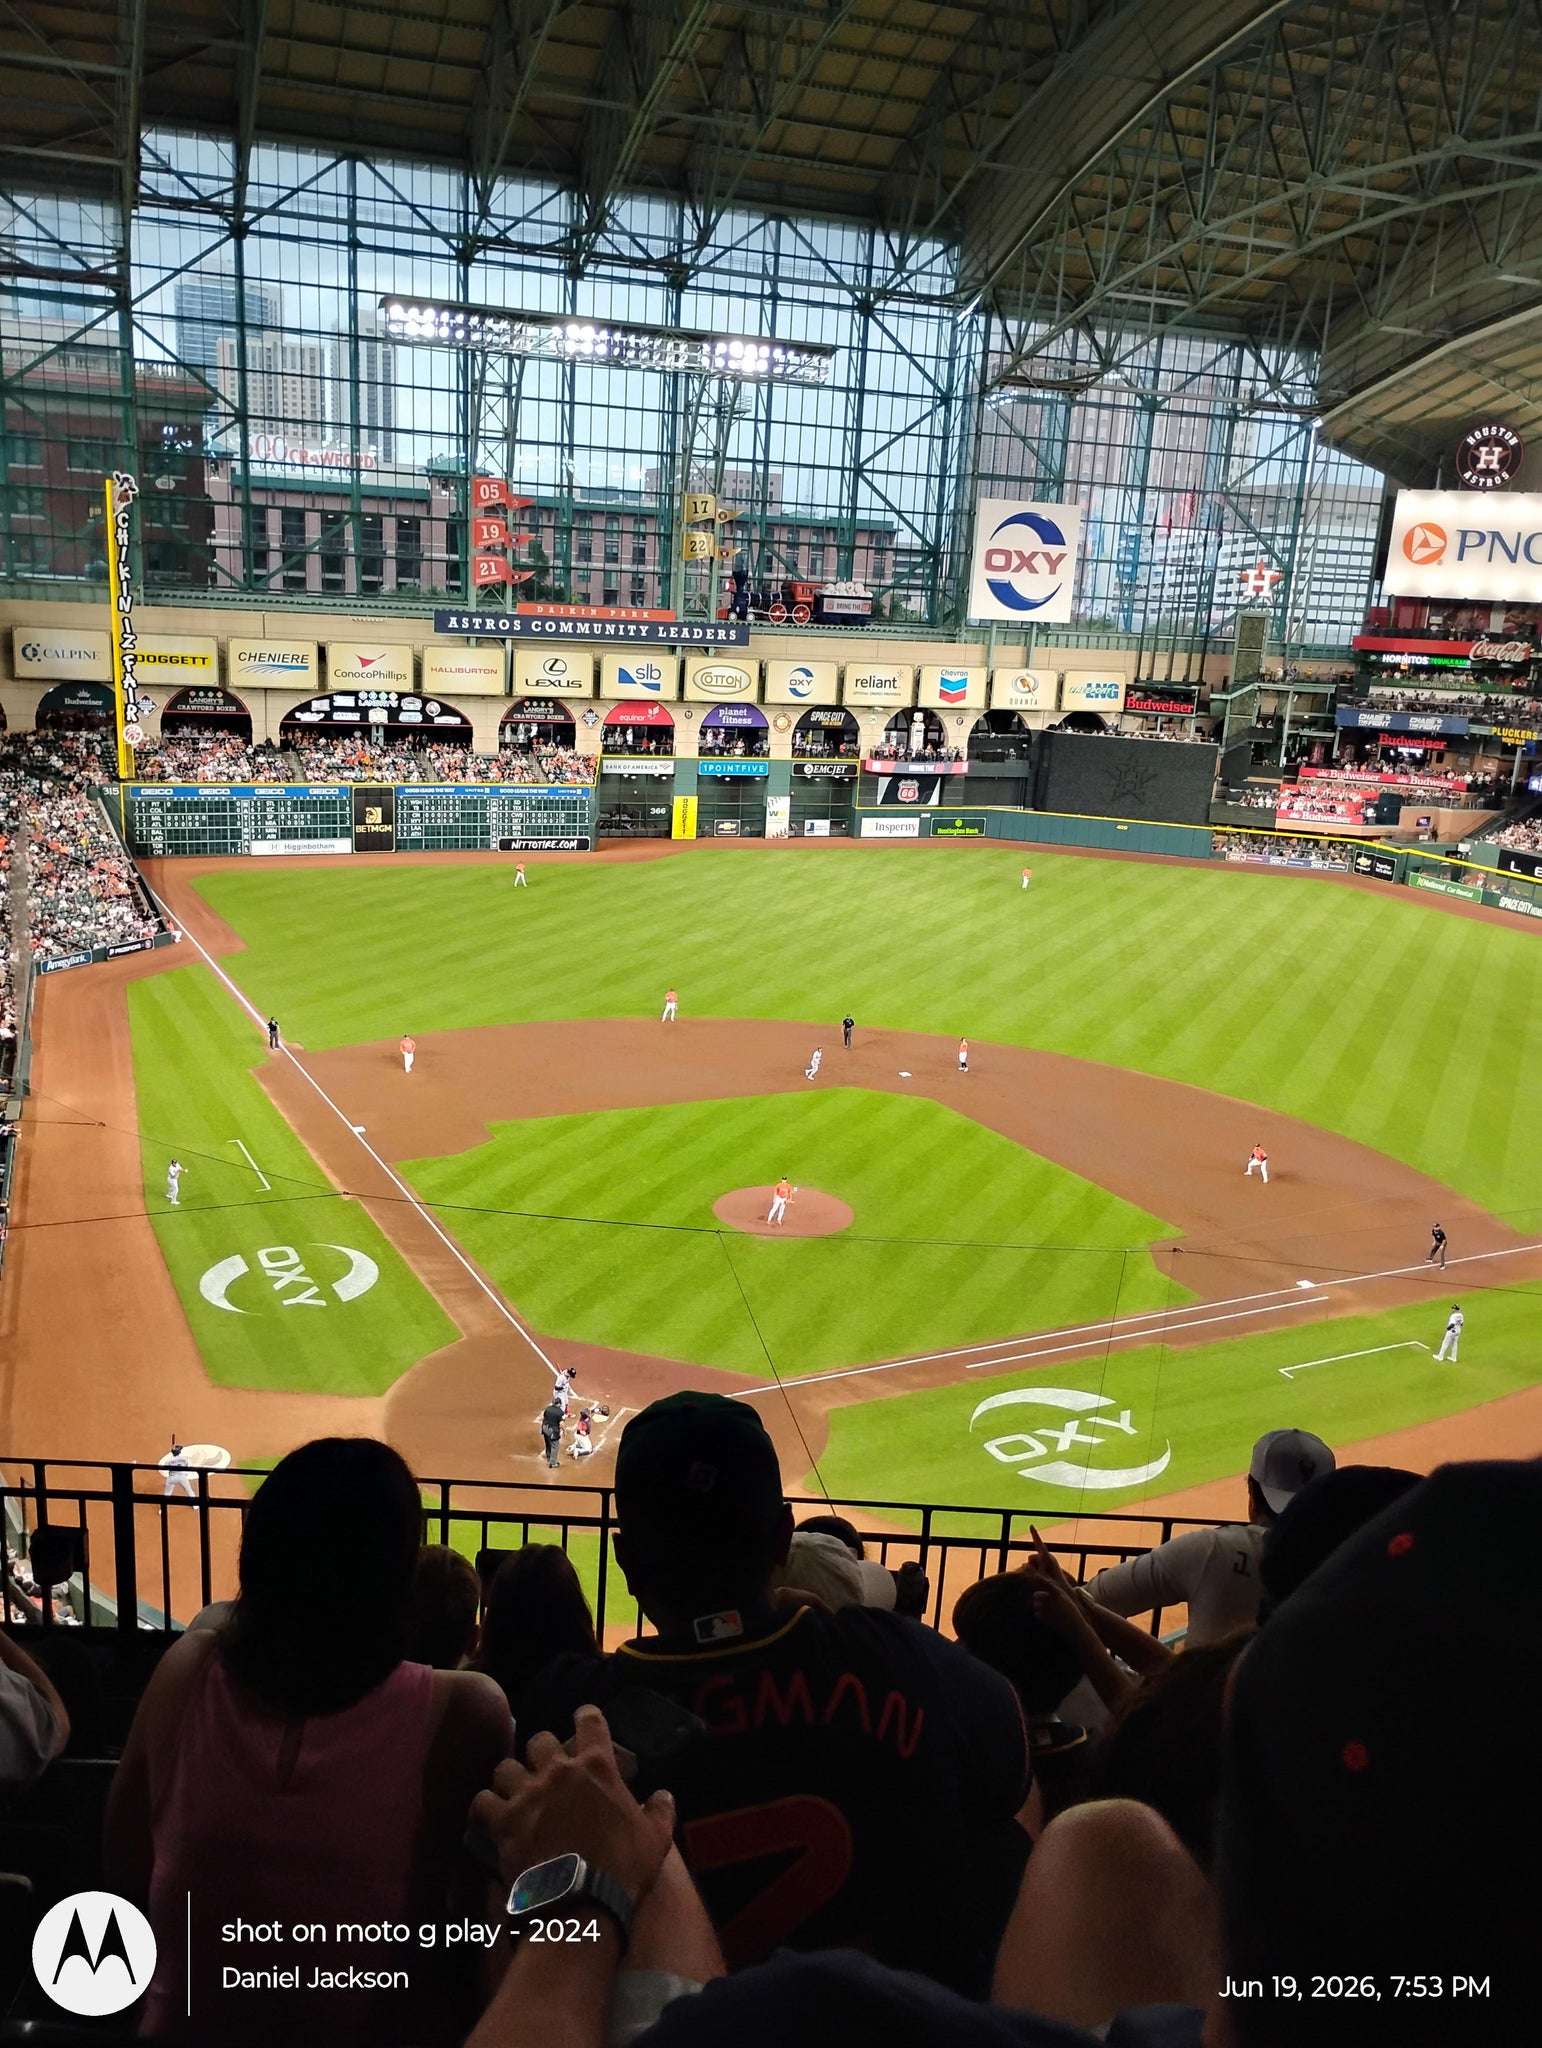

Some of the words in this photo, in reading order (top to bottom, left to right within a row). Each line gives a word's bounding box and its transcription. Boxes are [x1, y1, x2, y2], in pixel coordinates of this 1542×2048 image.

[1467, 426, 1518, 446] HOUSTON
[248, 434, 288, 461] 00
[289, 449, 374, 468] CRAWFORD
[1463, 470, 1509, 487] ASTROS
[480, 484, 500, 500] 05
[692, 500, 709, 514] 17
[481, 524, 500, 539] 19
[690, 540, 706, 552] 22
[114, 511, 134, 615] CHIKIN
[984, 547, 1069, 576] OXY
[480, 561, 498, 576] 21
[537, 605, 597, 617] DAIKIN
[610, 609, 650, 619] PARK
[120, 616, 138, 650] IZ
[448, 616, 522, 632] ASTROS
[531, 620, 650, 637] COMMUNITY
[657, 626, 737, 642] LEADERS
[43, 648, 101, 661] CALPINE
[136, 654, 209, 666] DOGGETT
[238, 651, 310, 664] CHENIERE
[1382, 653, 1430, 666] HORNITOS
[333, 668, 408, 682] ConocoPhillips
[430, 665, 499, 676] HALLIBURTON
[635, 663, 663, 681] slb
[940, 668, 969, 677] Chevron
[525, 678, 583, 689] LEXUS
[700, 671, 744, 689] COTTON
[789, 678, 813, 687] OXY
[855, 675, 898, 689] reliant
[121, 653, 140, 723] FAIR
[1068, 685, 1114, 696] FREEPORT
[1085, 682, 1120, 700] LNG
[64, 697, 104, 707] Budweiser
[1009, 697, 1039, 706] QUANTA
[1126, 696, 1194, 714] Budweiser
[619, 714, 646, 722] equinor
[718, 707, 748, 717] planet
[810, 711, 832, 721] SPACE
[831, 712, 846, 722] CITY
[722, 715, 753, 725] fitness
[1491, 727, 1538, 740] PLUCKERS
[1379, 733, 1447, 749] Budweiser
[703, 764, 765, 774] 1POINTFIVE
[814, 765, 848, 775] EMCJET
[1330, 769, 1381, 782] Budweiser
[1410, 775, 1454, 789] Budweiser
[102, 786, 120, 796] 315
[140, 788, 173, 796] GEICO
[198, 788, 231, 796] GEICO
[901, 788, 915, 797] 66
[1300, 811, 1352, 824] Budweiser
[355, 824, 393, 833] BETMGM
[875, 822, 917, 834] Insperity
[937, 828, 965, 836] Huntington
[284, 843, 335, 852] Higginbotham
[511, 840, 578, 850] NITTOTIRE.COM
[1424, 880, 1446, 891] National
[1447, 886, 1457, 894] Car
[1456, 888, 1474, 898] Rental
[1498, 896, 1518, 910] SPACE
[1517, 899, 1533, 914] CITY
[257, 1246, 328, 1307] OXY
[983, 1409, 1139, 1463] OXY
